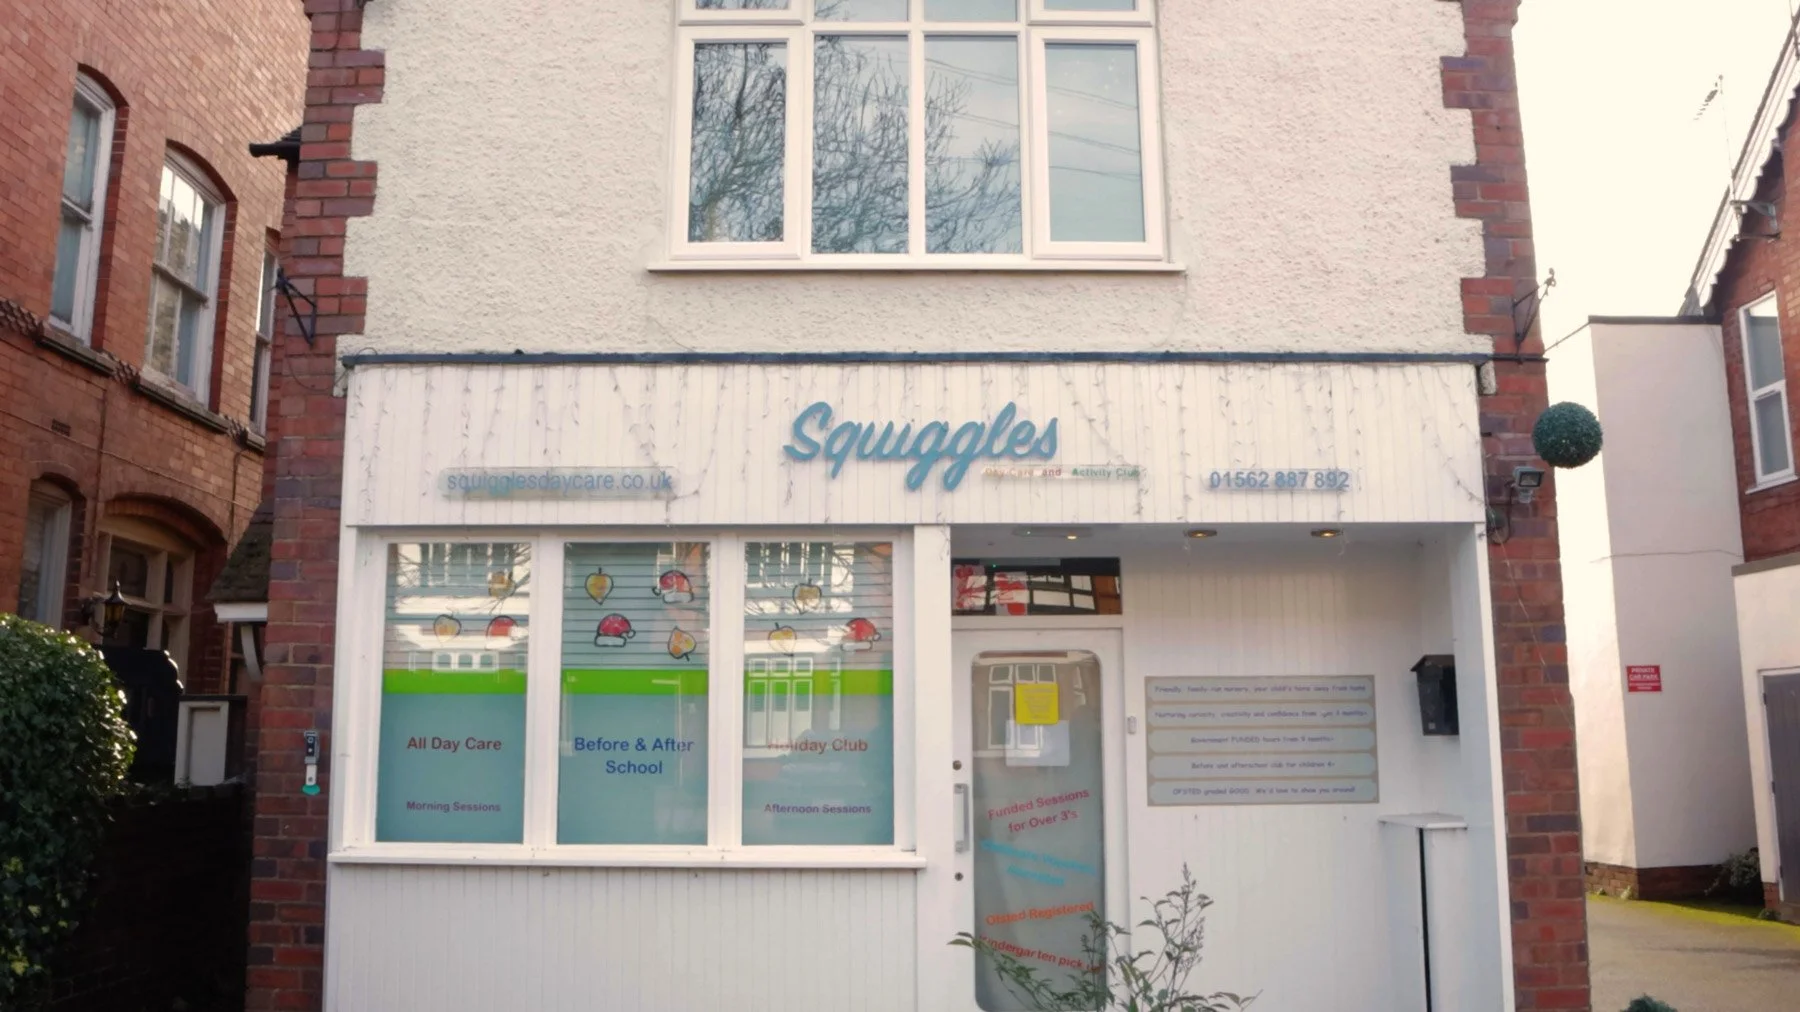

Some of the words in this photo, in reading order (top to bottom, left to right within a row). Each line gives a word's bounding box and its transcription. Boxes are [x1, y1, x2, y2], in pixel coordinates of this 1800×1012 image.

[782, 401, 1059, 492] Squiggles
[1042, 467, 1062, 477] and
[1071, 467, 1112, 479] Activity
[1115, 467, 1141, 478] Club
[1209, 471, 1269, 489] 01562
[1275, 471, 1309, 488] 887
[1314, 470, 1351, 489] 892
[447, 470, 673, 497] squigglesdaycare.co.uk
[407, 737, 427, 750] All
[431, 737, 459, 752] Day
[465, 737, 502, 751] Care
[574, 737, 630, 752] Before
[636, 737, 648, 751] &
[651, 737, 694, 751] After
[832, 738, 869, 751] Club
[1231, 736, 1261, 744] FUNDED
[605, 760, 663, 774] School
[1172, 787, 1203, 796] OFSTED
[406, 801, 450, 811] Morning
[453, 801, 501, 812] Sessions
[763, 803, 820, 813] Afternoon
[822, 803, 872, 814] Sessions
[988, 801, 1034, 820] Funded
[1036, 789, 1090, 808] Sessions
[1008, 822, 1026, 832] for
[1029, 814, 1058, 828] Over
[1060, 809, 1078, 821] 3's
[985, 909, 1027, 925] Ofsted
[1029, 901, 1094, 919] Registered
[980, 933, 1057, 964] indergarten
[1058, 956, 1083, 968] pick
